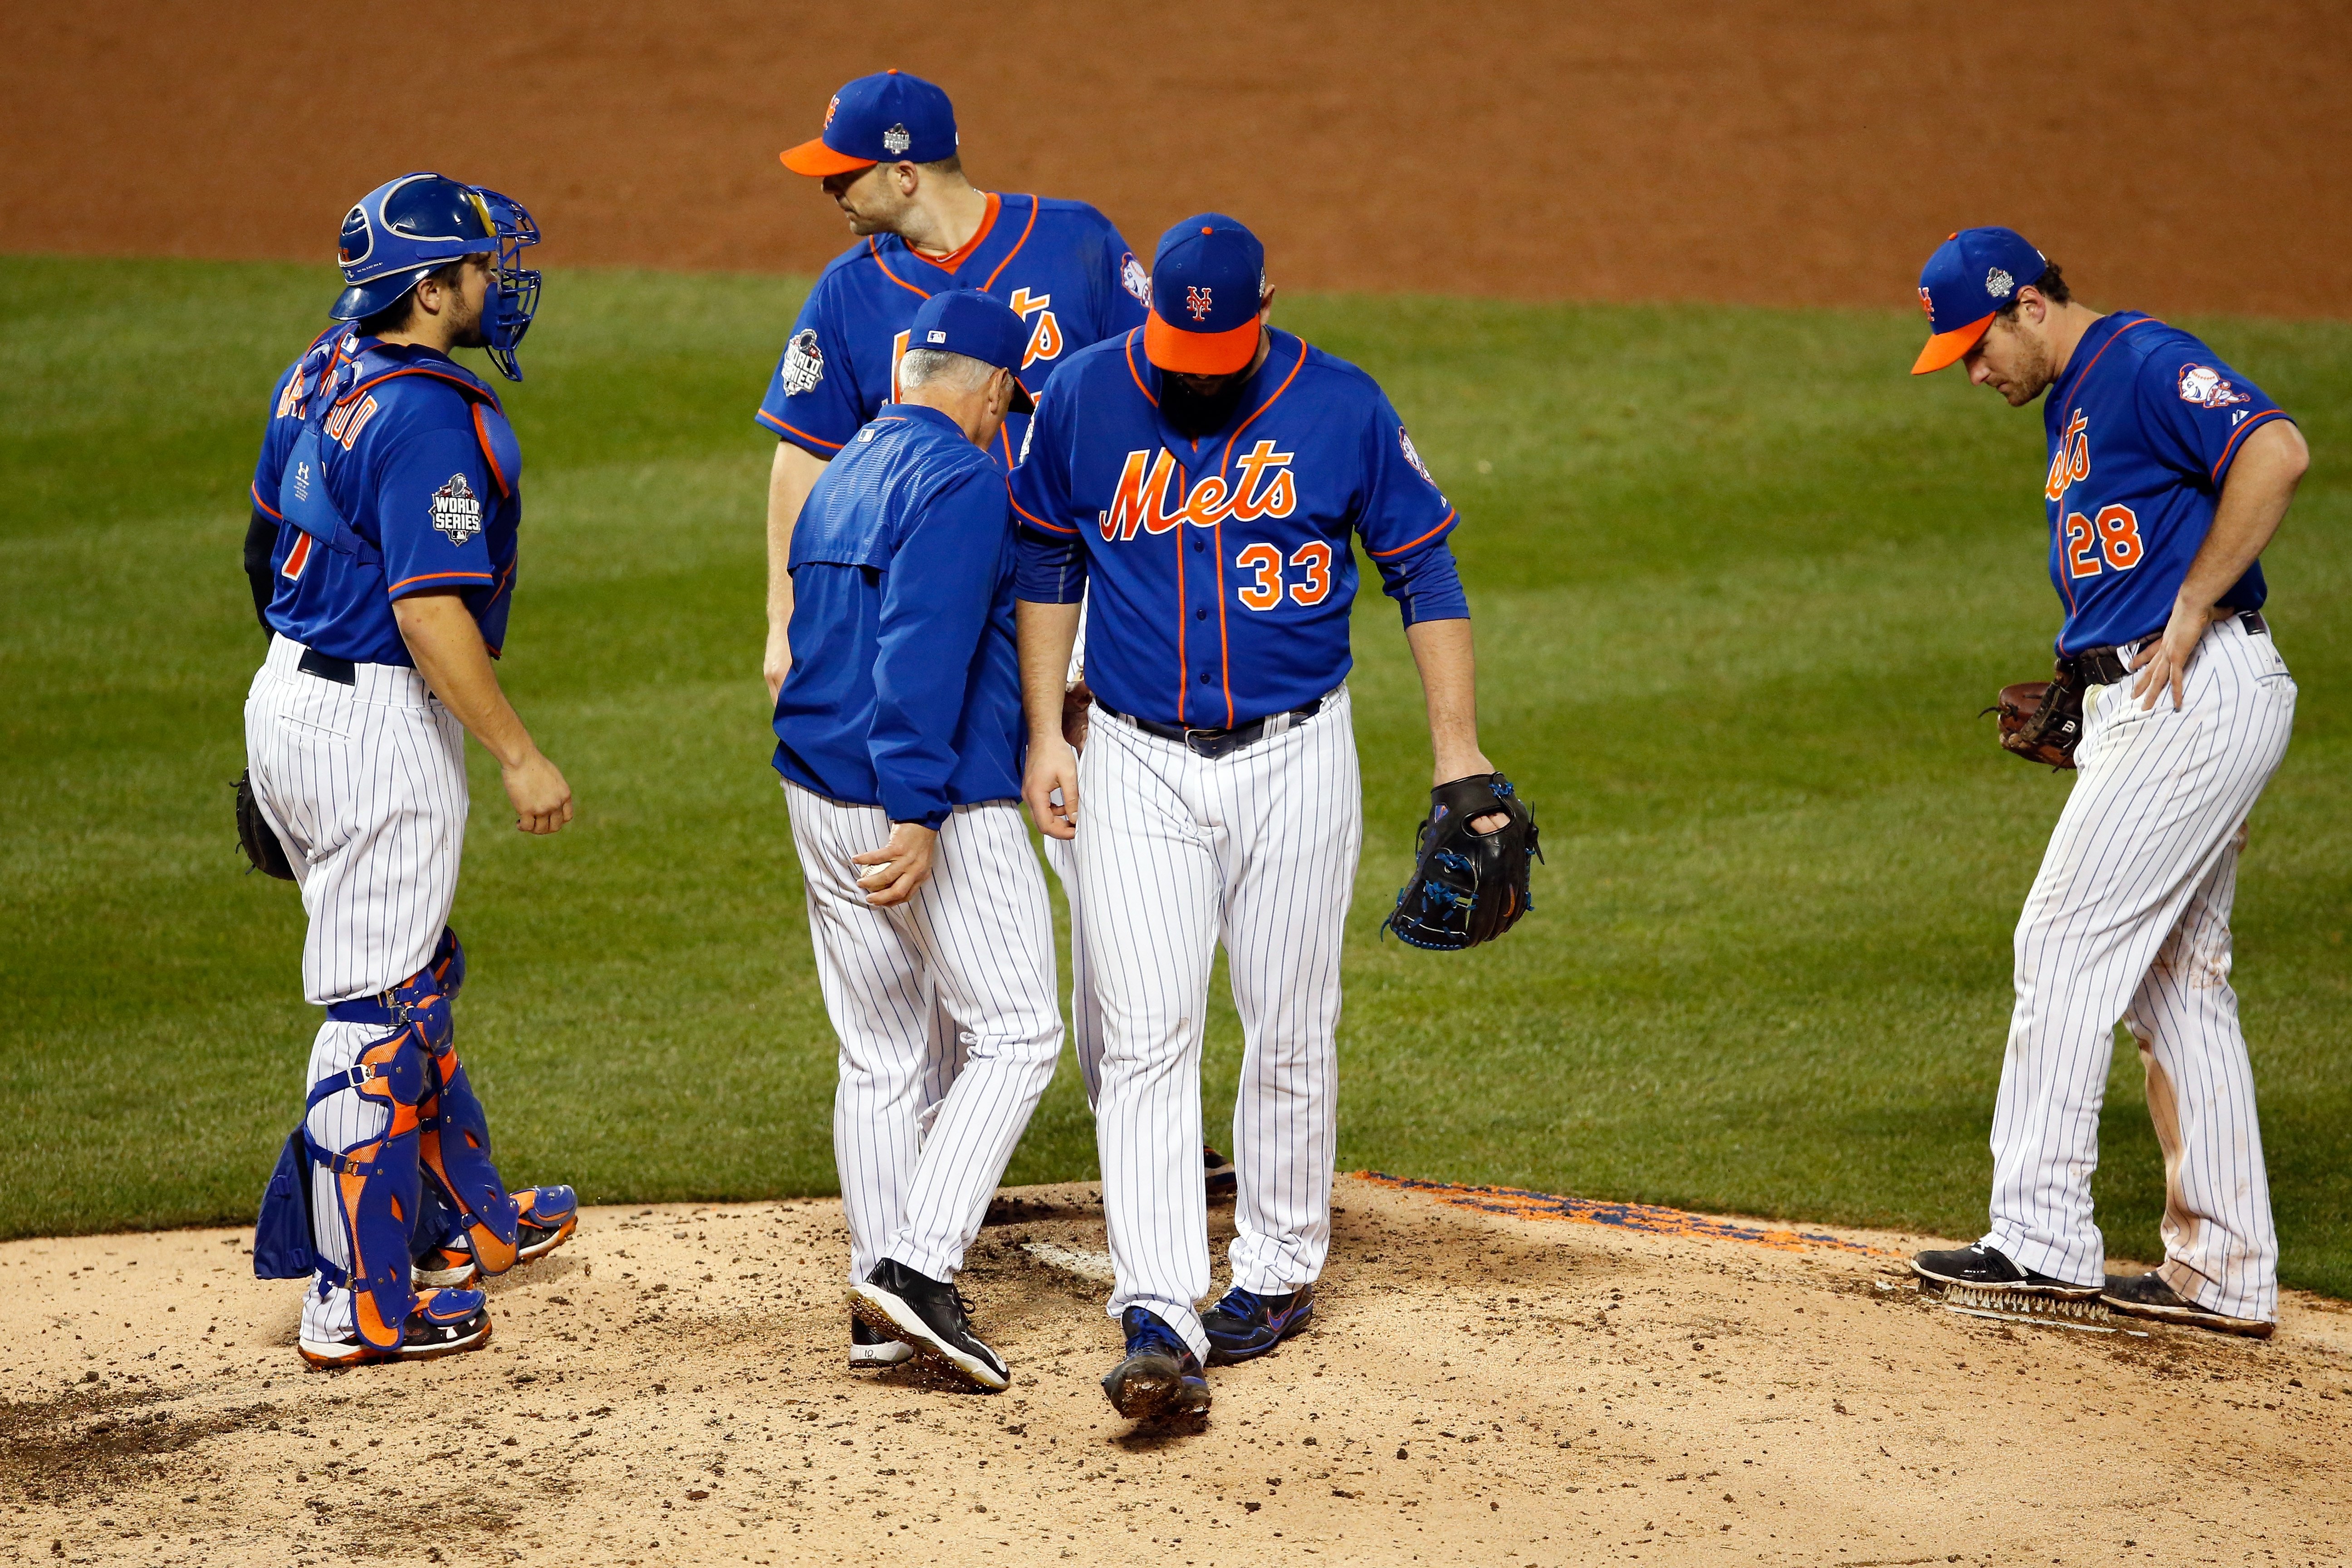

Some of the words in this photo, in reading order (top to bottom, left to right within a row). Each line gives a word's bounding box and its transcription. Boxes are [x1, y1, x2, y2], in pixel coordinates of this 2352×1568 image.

[1186, 286, 1212, 321] NY
[787, 344, 821, 376] WORLD
[2045, 408, 2090, 502] ets
[435, 496, 478, 514] WORLD
[1099, 440, 1297, 542] Mets
[436, 513, 479, 530] SERIES
[2066, 503, 2144, 579] 28
[1236, 540, 1332, 611] 33
